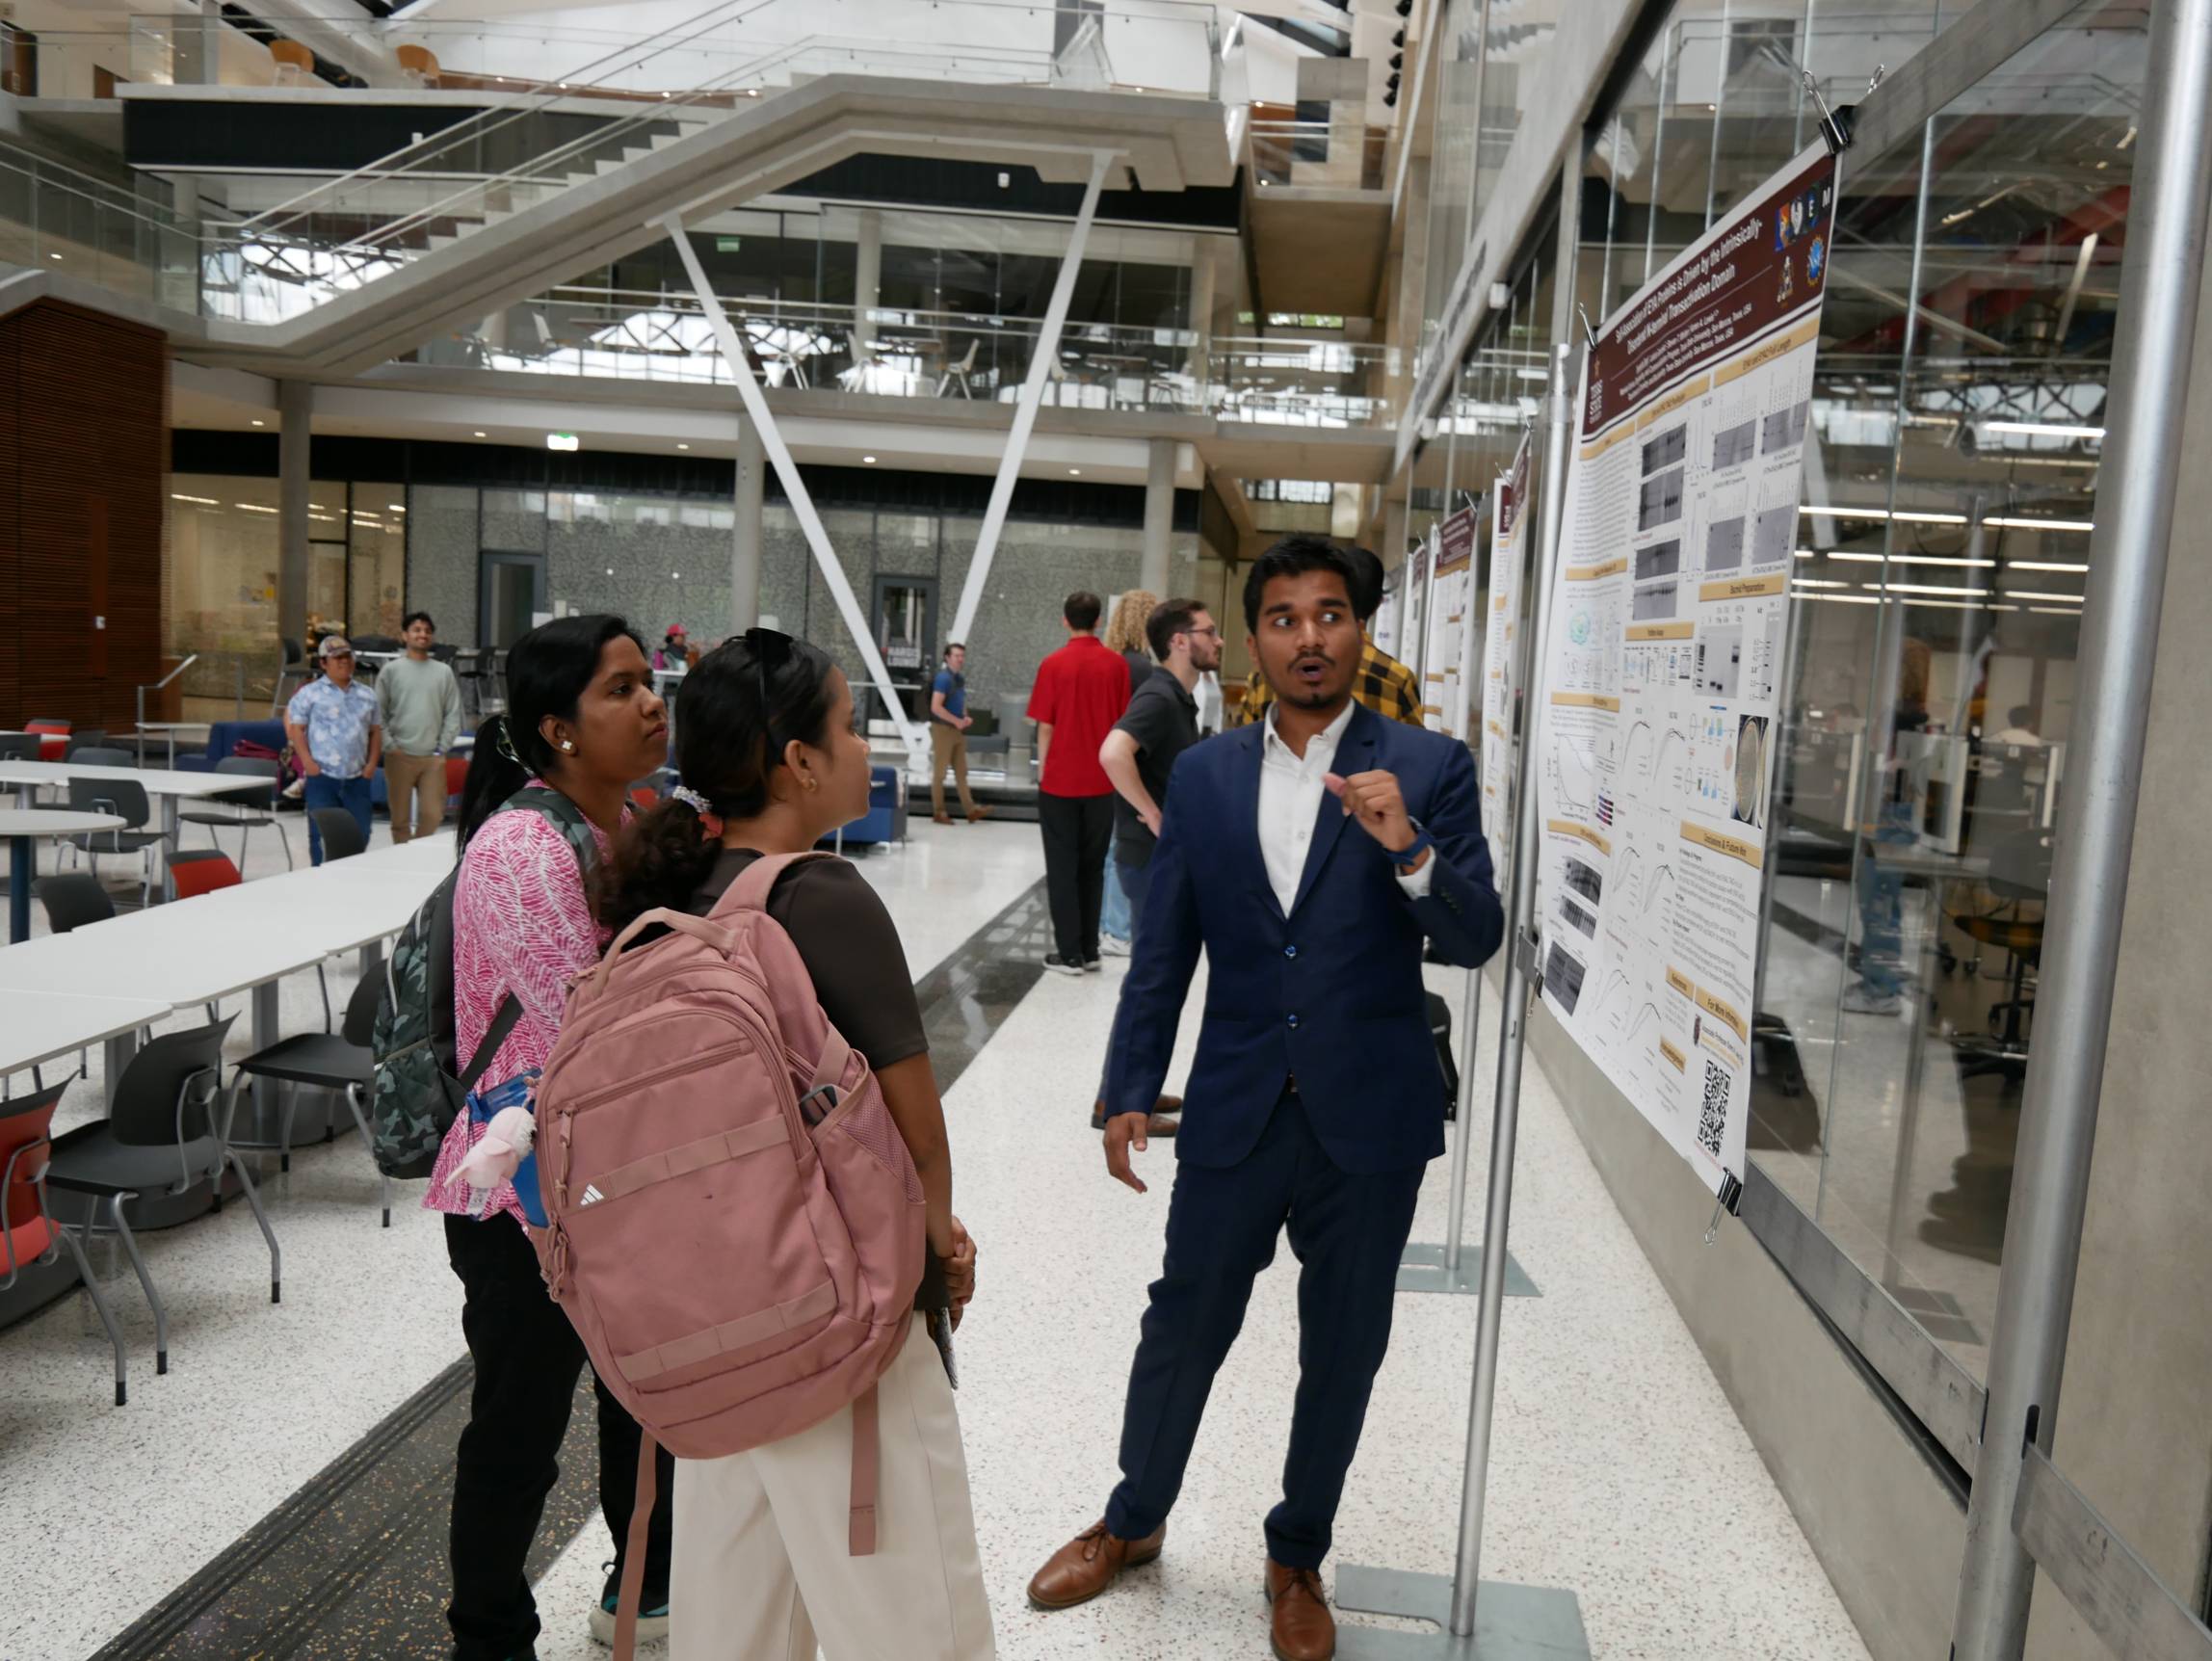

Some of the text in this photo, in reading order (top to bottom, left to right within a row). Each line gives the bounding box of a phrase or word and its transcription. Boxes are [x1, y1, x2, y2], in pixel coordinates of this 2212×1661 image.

[1700, 255, 1709, 276] by
[1710, 248, 1720, 267] the
[1711, 263, 1735, 292] Domain
